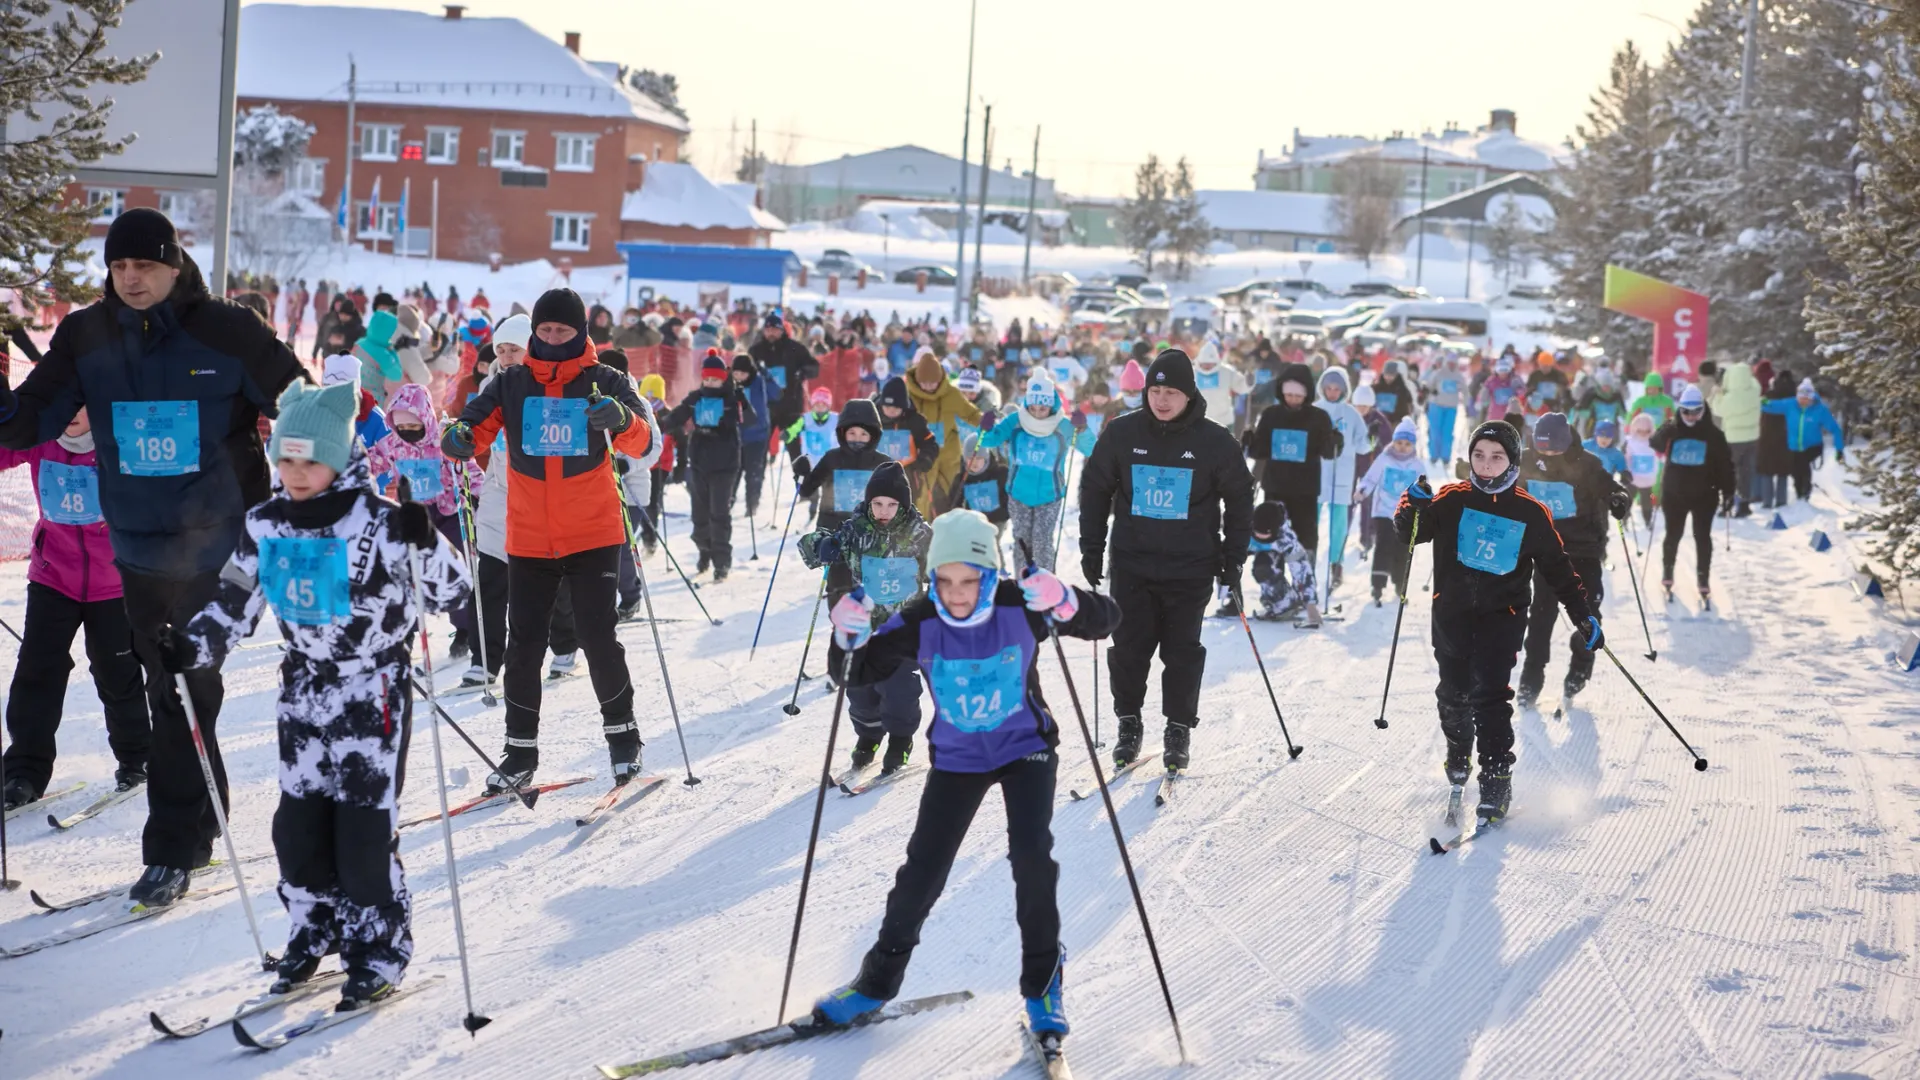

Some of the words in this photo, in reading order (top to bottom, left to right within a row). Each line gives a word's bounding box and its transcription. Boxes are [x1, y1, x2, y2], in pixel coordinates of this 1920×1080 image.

[1670, 307, 1694, 406] СТАР
[540, 424, 572, 444] 200
[136, 437, 177, 462] 189
[1026, 450, 1046, 462] 167
[409, 477, 429, 492] 217
[60, 492, 85, 513] 48
[1144, 488, 1173, 507] 102
[1475, 538, 1497, 560] 75
[285, 578, 315, 608] 45
[880, 579, 900, 595] 55
[955, 689, 1002, 719] 124
